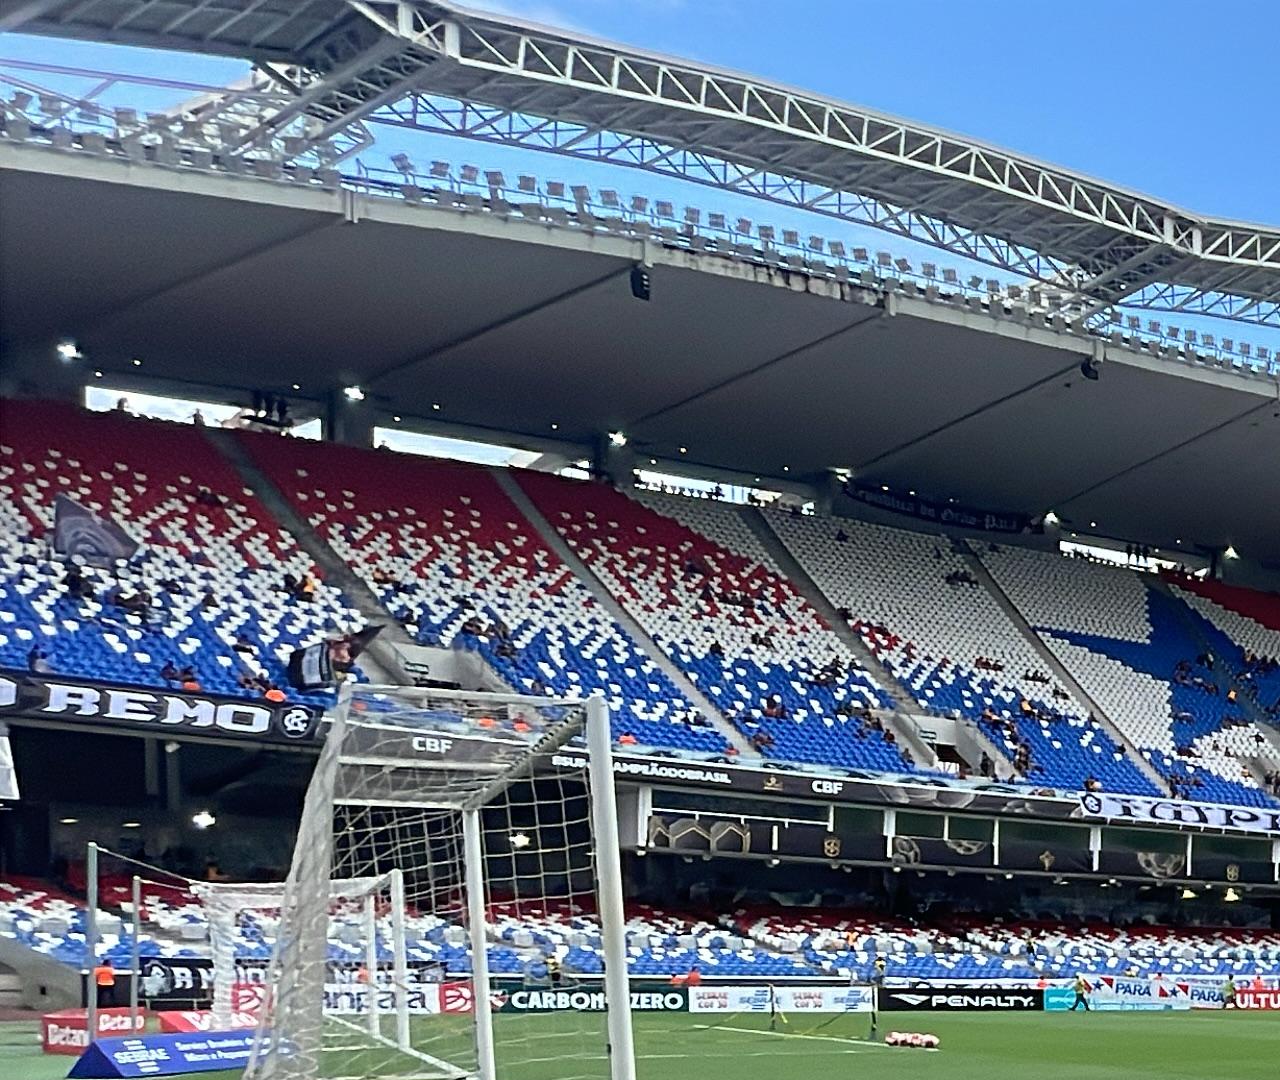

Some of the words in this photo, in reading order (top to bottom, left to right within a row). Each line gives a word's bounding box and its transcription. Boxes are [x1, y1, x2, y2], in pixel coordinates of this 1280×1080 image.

[42, 683, 271, 733] REMO
[412, 736, 453, 754] CBF
[811, 780, 843, 795] CBF
[511, 992, 604, 1011] CARBON
[631, 992, 683, 1009] ZERO
[932, 995, 1031, 1007] PENALTY
